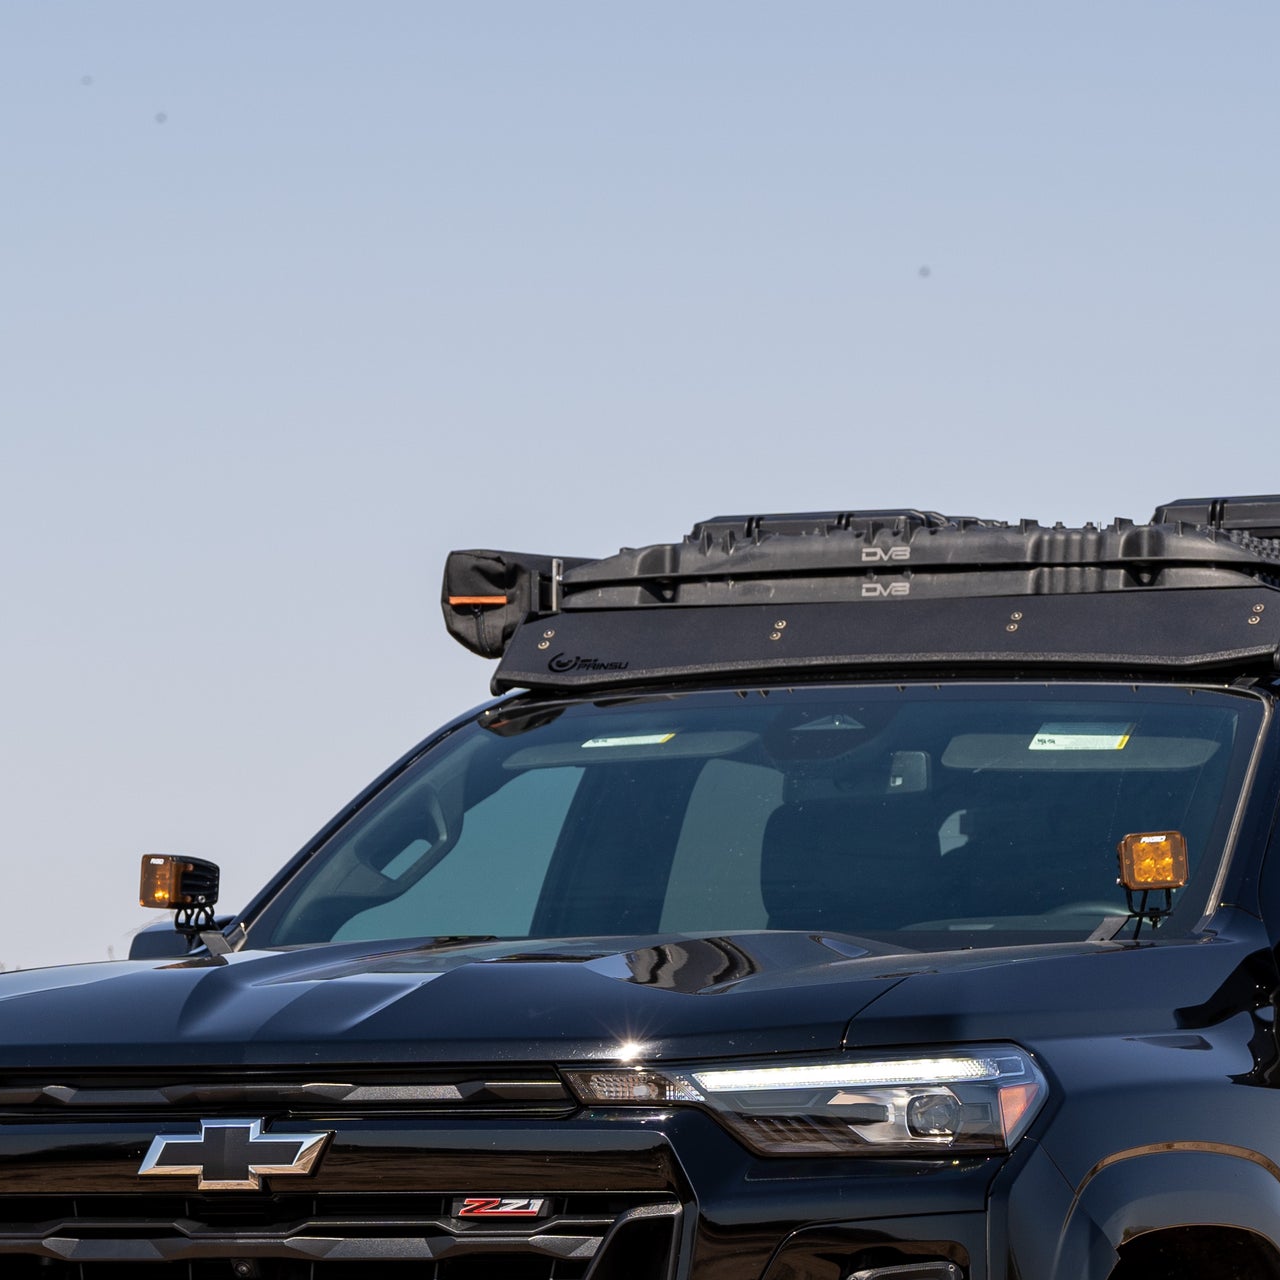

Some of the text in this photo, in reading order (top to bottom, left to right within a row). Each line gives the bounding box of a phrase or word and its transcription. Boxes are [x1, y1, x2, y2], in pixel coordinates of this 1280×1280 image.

[861, 547, 911, 561] DV8
[861, 582, 910, 597] DV8
[458, 1198, 544, 1216] Z71
